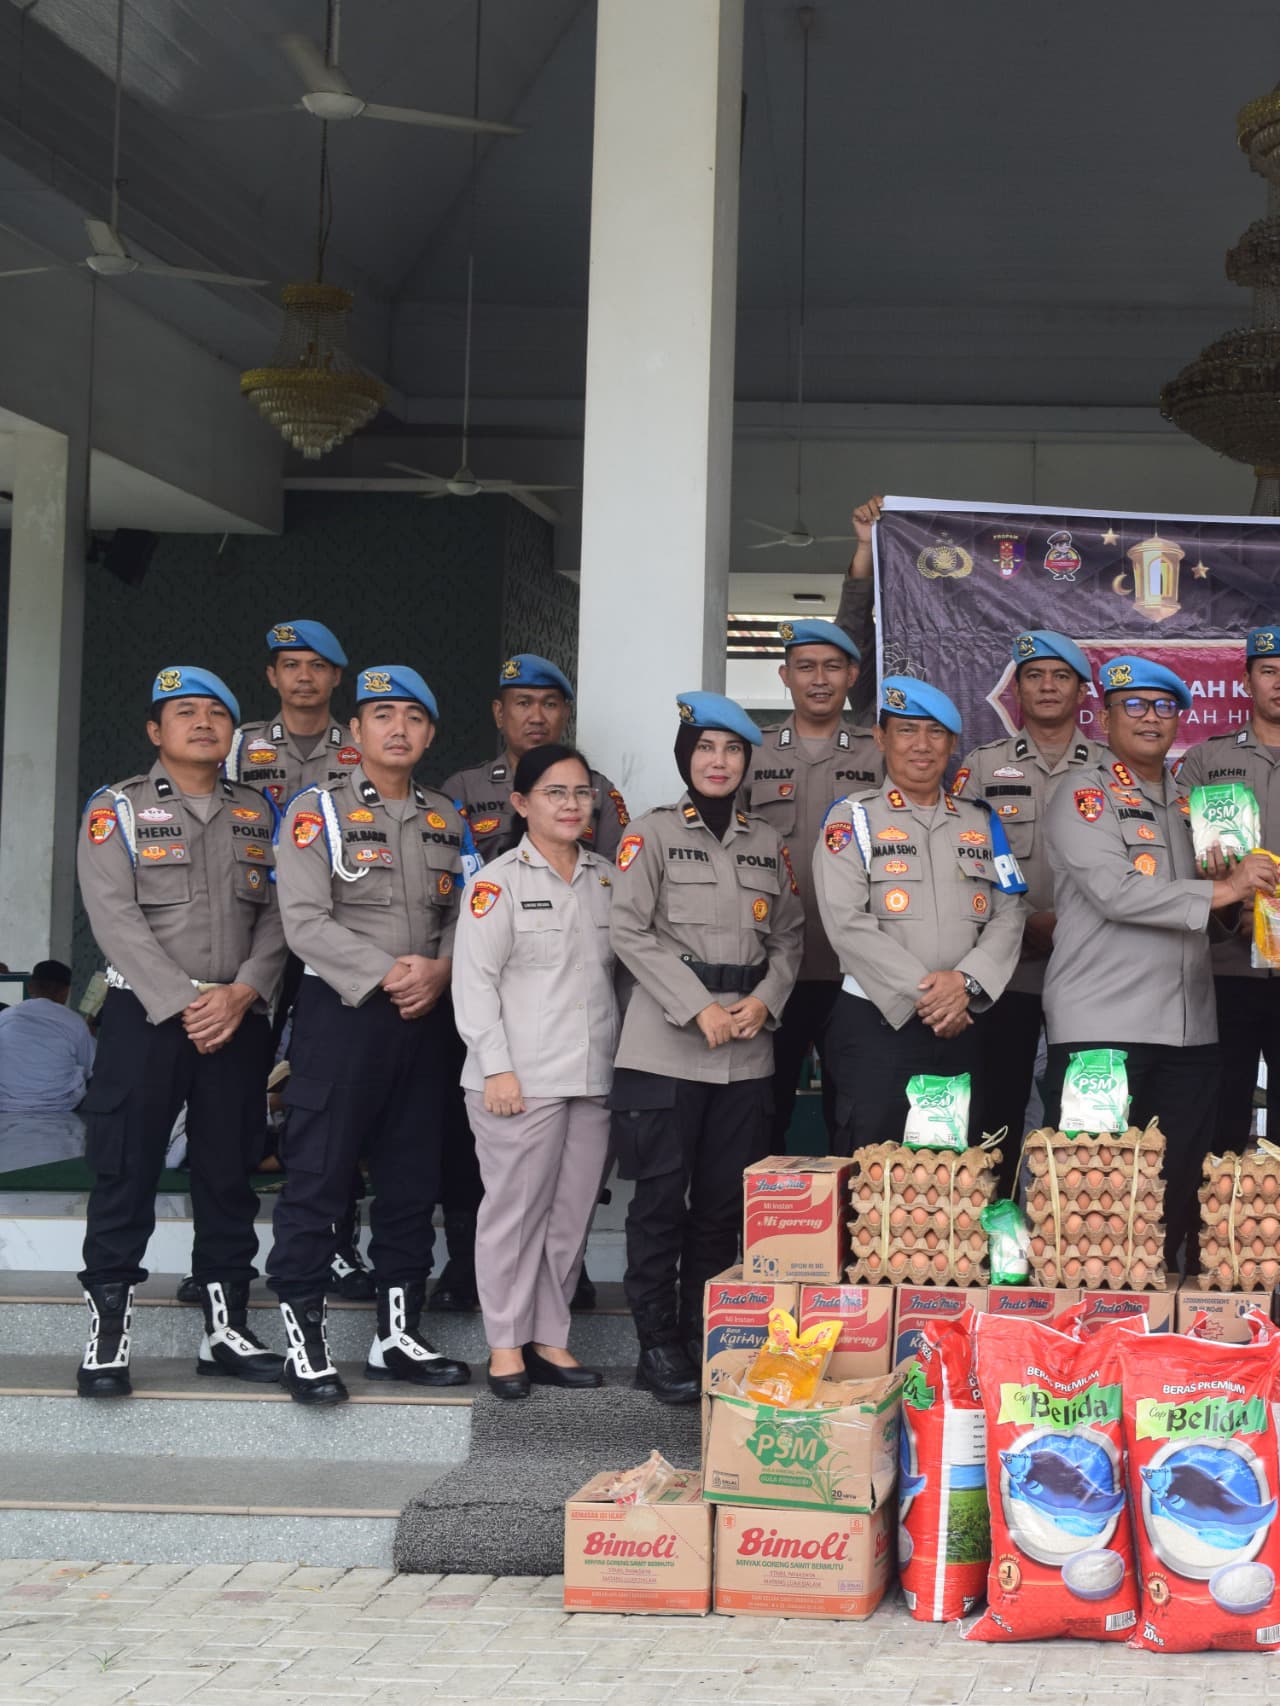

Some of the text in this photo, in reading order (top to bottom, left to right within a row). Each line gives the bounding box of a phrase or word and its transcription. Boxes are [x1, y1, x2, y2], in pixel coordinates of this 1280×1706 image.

[754, 768, 794, 780] RULLY
[835, 770, 875, 782] POLRI
[1208, 769, 1247, 780] FAKHRI
[1208, 805, 1235, 821] PSM
[137, 827, 183, 838] HERU
[232, 825, 270, 840] POLRI
[668, 848, 709, 863] FITRI
[736, 854, 777, 869] POLRI
[958, 847, 993, 861] POLRI
[1079, 1077, 1112, 1090] PSM
[778, 1217, 823, 1230] goreng
[1163, 1380, 1246, 1395] BERAS PREMIUM
[1030, 1391, 1109, 1426] Belida
[1166, 1404, 1249, 1433] Belida
[756, 1433, 819, 1461] PSM
[832, 1490, 843, 1498] 20
[583, 1531, 677, 1558] Bimoli
[737, 1527, 850, 1561] Bimoli
